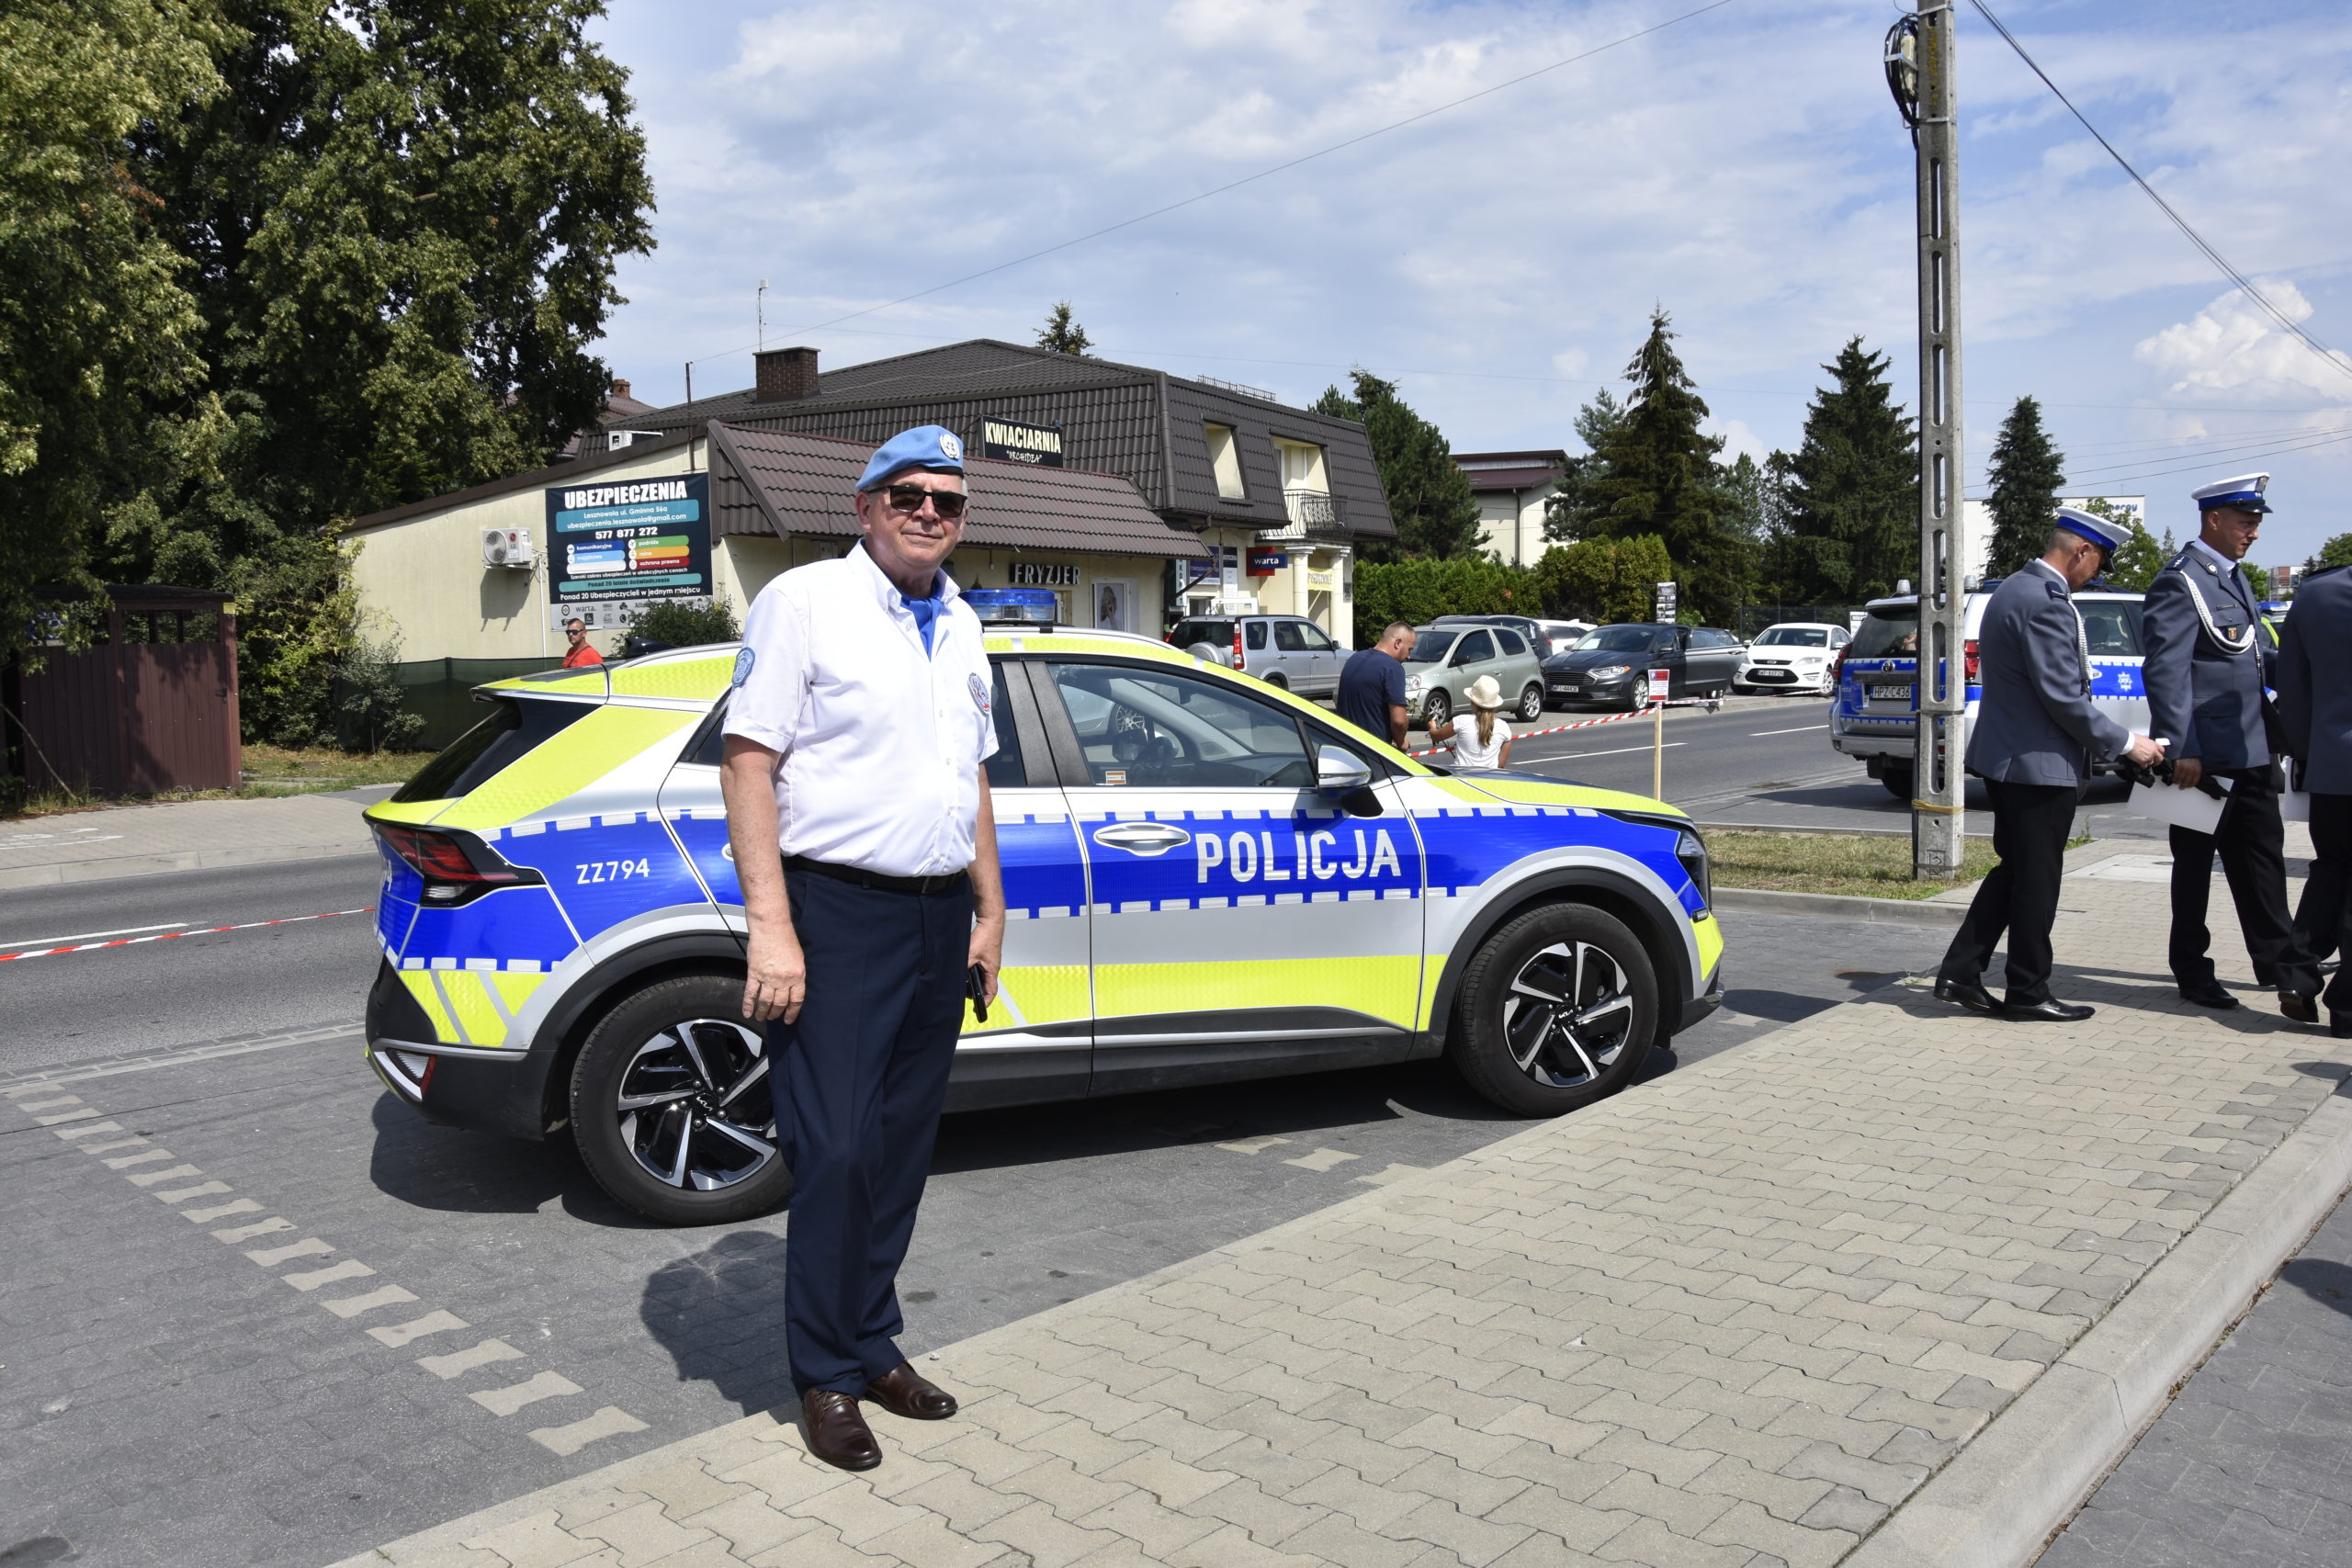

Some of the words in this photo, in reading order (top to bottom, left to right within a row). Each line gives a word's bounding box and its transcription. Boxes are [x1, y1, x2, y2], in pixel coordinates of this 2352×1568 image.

[985, 422, 1061, 453] KWIACIARNIA
[564, 480, 687, 509] UBEZPIECZENIA
[567, 513, 686, 529] ubezpieczenia.lesznowola@gmail.com
[583, 510, 618, 519] Lesznowola
[629, 506, 654, 514] Gminna
[595, 530, 613, 539] 577
[616, 528, 635, 537] 877
[639, 526, 658, 536] 272
[1014, 564, 1081, 585] FRYZJER
[590, 590, 640, 600] Ubezpieczycieli
[648, 588, 673, 596] jednym
[673, 587, 701, 595] miejscu
[1874, 686, 1889, 697] HPZ
[1891, 686, 1910, 697] C436
[1195, 829, 1402, 883] POLICJA
[576, 858, 650, 885] ZZ794
